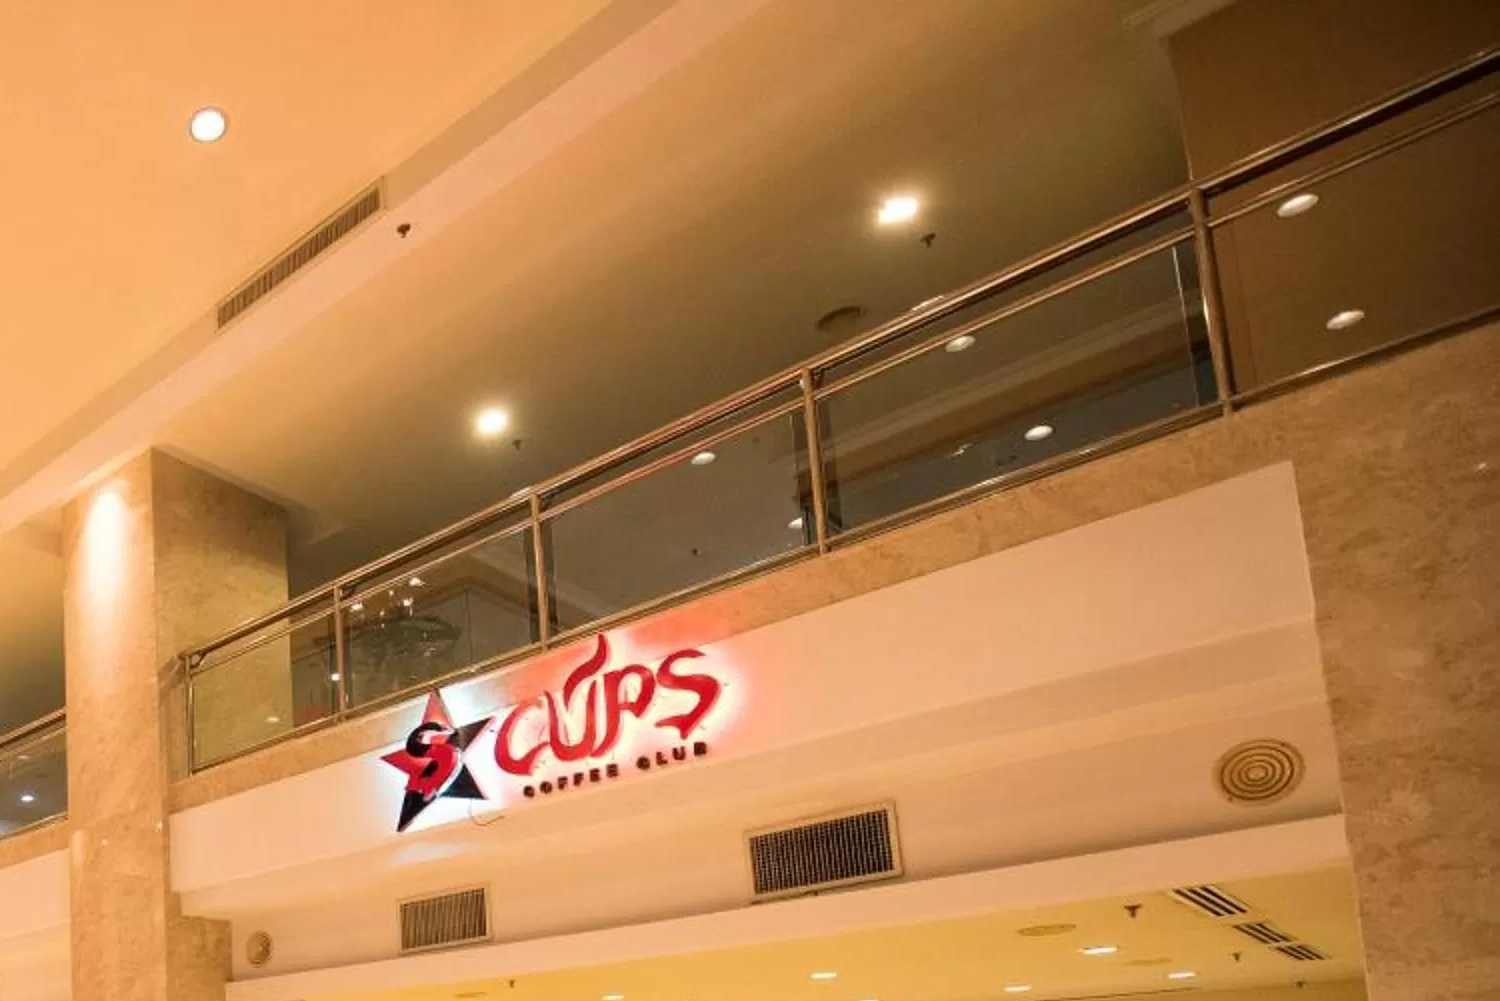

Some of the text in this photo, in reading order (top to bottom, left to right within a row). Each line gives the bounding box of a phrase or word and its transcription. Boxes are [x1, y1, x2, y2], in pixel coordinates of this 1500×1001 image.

[494, 633, 722, 776] CUPS
[522, 741, 708, 799] COFFEE CLUB
